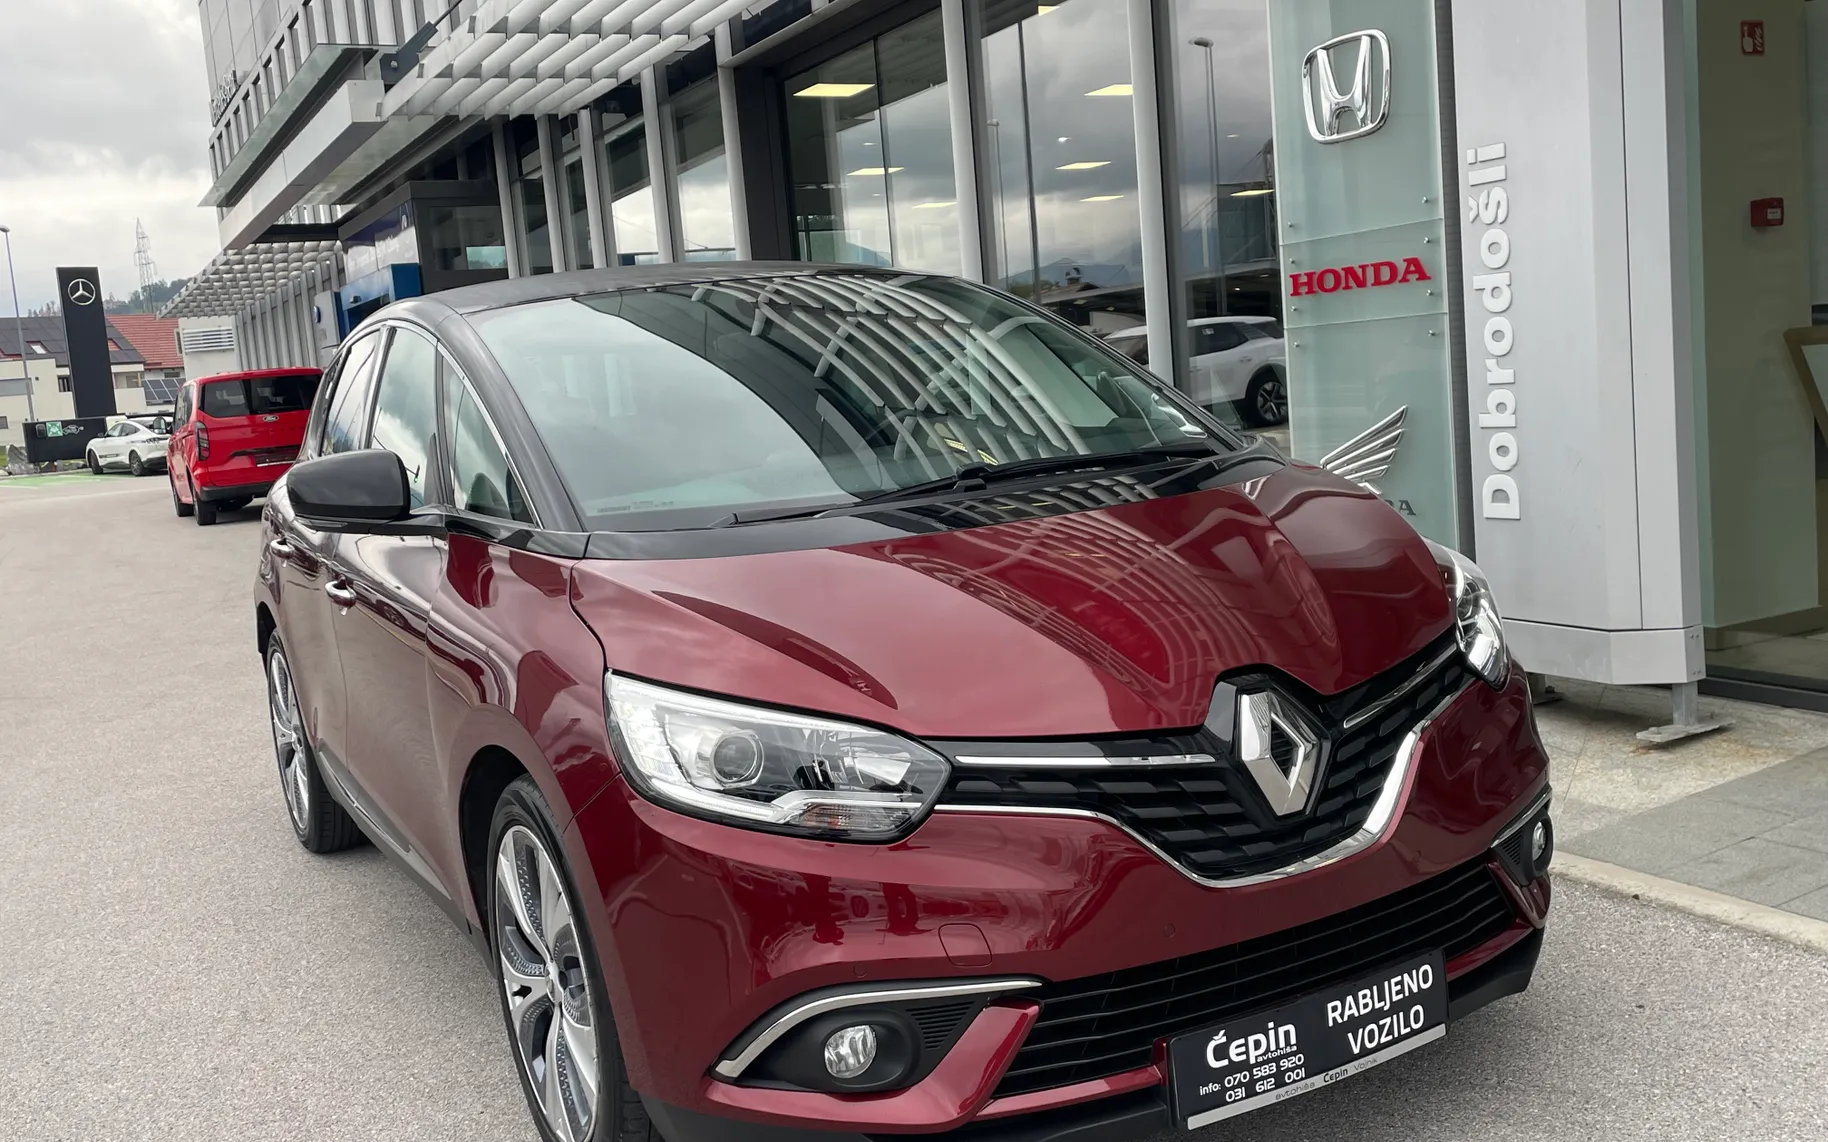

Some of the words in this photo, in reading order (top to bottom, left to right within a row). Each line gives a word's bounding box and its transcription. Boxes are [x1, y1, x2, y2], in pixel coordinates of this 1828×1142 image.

[1289, 256, 1431, 296] HONDA
[1466, 141, 1521, 520] Dobrodošli
[1327, 964, 1433, 1027] RABLJENO
[1206, 1021, 1297, 1069] Čepin
[1347, 1004, 1424, 1055] VOZILO
[1199, 1082, 1222, 1096] info:
[1224, 1071, 1250, 1088] 070
[1253, 1062, 1277, 1079] 583
[1280, 1053, 1305, 1071] 920
[1257, 1045, 1298, 1063] avtohiša
[1225, 1086, 1246, 1102] 031
[1255, 1077, 1276, 1093] 612
[1284, 1067, 1306, 1083] 001
